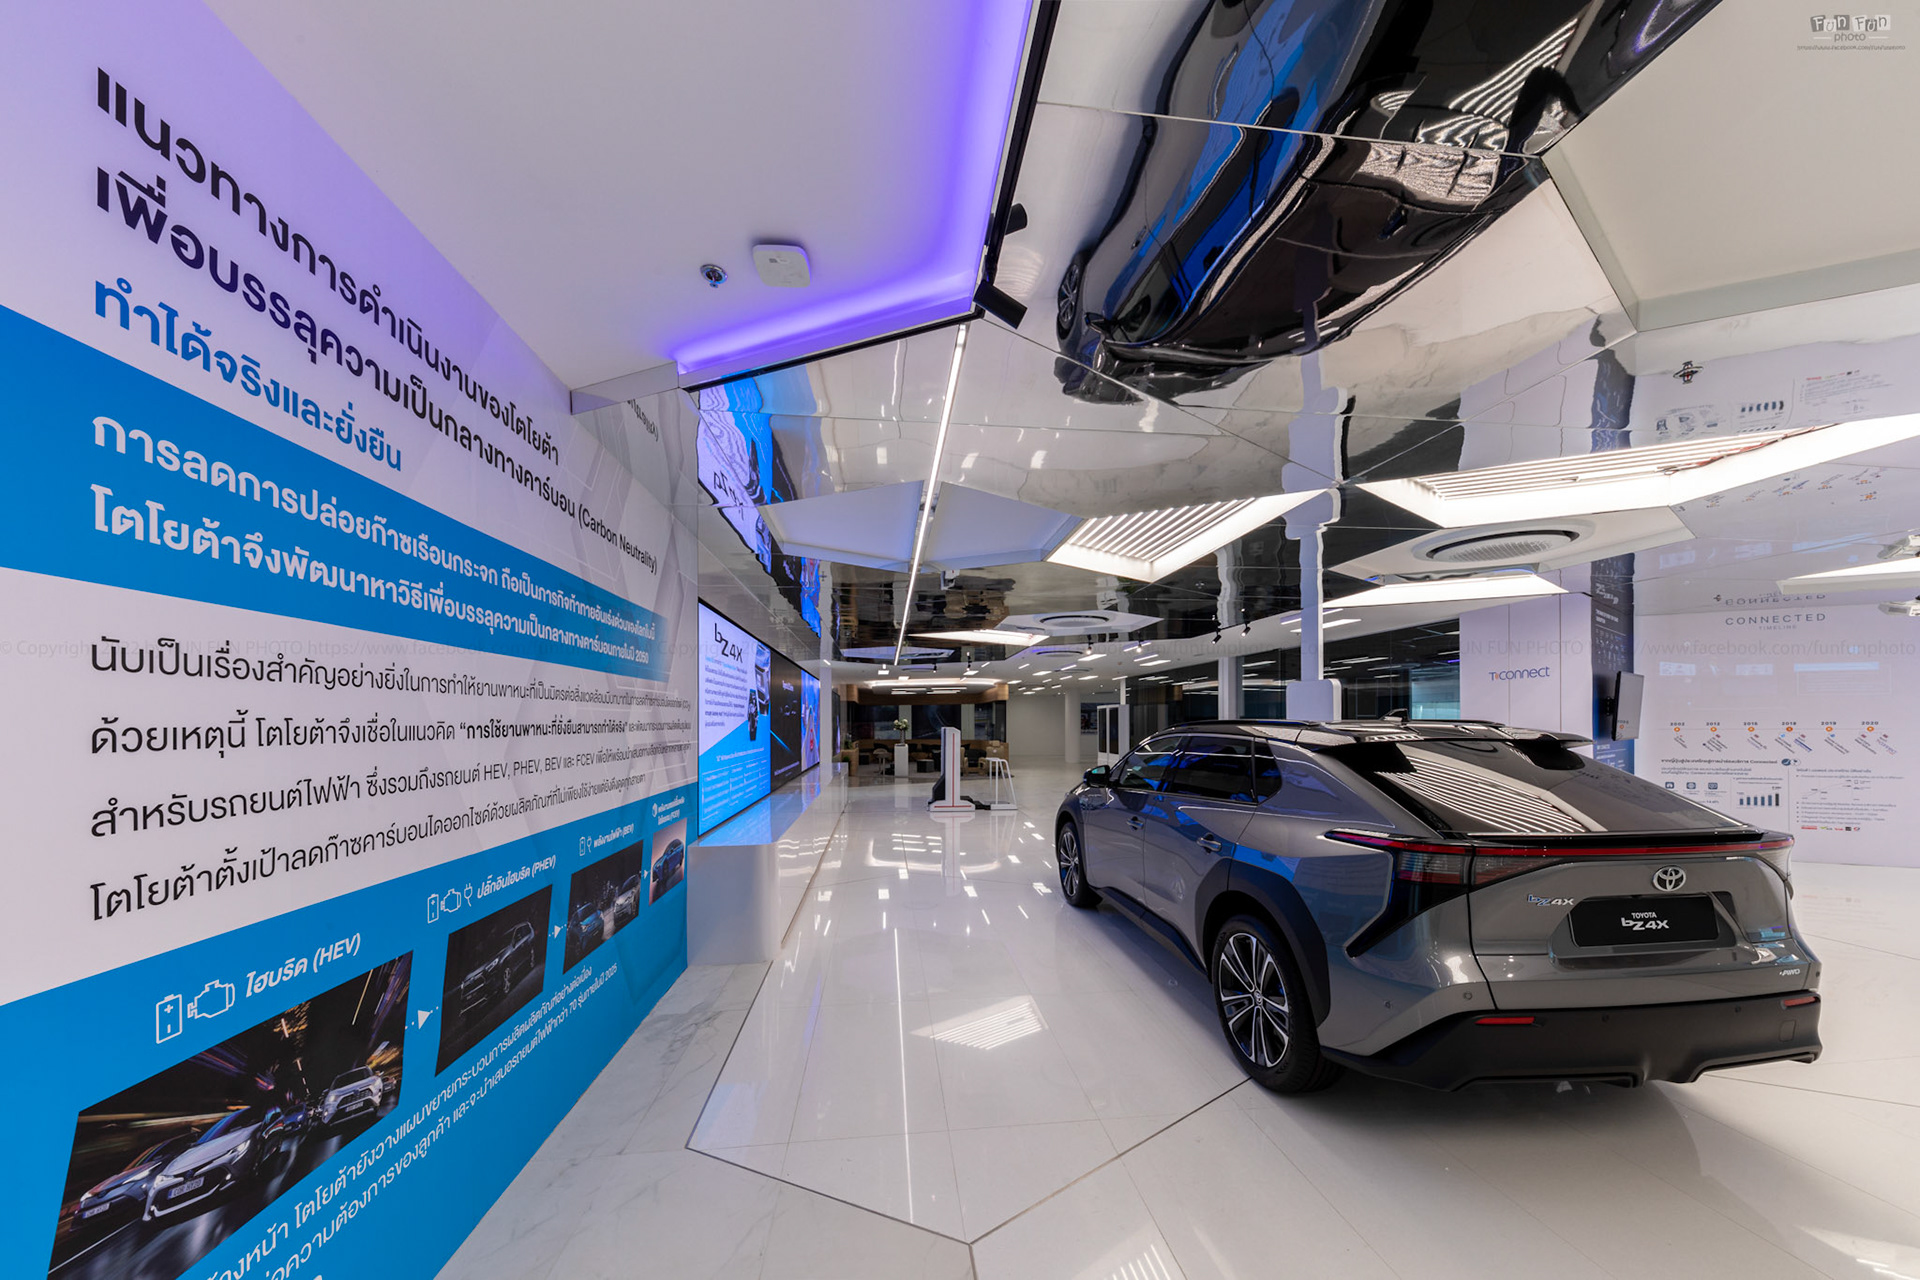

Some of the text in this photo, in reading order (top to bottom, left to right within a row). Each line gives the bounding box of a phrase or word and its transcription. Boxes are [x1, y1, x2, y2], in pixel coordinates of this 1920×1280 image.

[97, 66, 559, 466] แนวทางการดำเนินงานของโตโยต้า
[95, 277, 402, 472] ทำได้จริงและยั่งยืน
[97, 166, 658, 576] เพื่อบรรลุความเป็นกลางทางคาร์บอน (Carbon Neutrality)
[92, 416, 498, 586] การลดการปล่อยก๊าซเรือนกระจก
[1725, 613, 1826, 626] CONNECTED
[635, 650, 649, 664] 2050
[91, 709, 249, 758] ด้วยเหตุนี้
[256, 712, 455, 747] โตโยต้าจึงเชื่อในแนวคิด
[91, 774, 360, 837] สำหรับรถยนต์ไฟฟ้า
[367, 761, 480, 797] ซึ่งรวมถึงรถยนต์
[484, 762, 510, 781] HEV,
[513, 759, 542, 777] PHEV,
[544, 755, 562, 771] BEV
[563, 756, 574, 769] และ
[576, 752, 595, 766] FCEV
[476, 854, 556, 899] ปลั๊กอินไฮบริด (PHEV)
[246, 932, 361, 998] ไฮบริด (HEV)
[569, 1000, 577, 1013] 70
[604, 963, 618, 981] 2025
